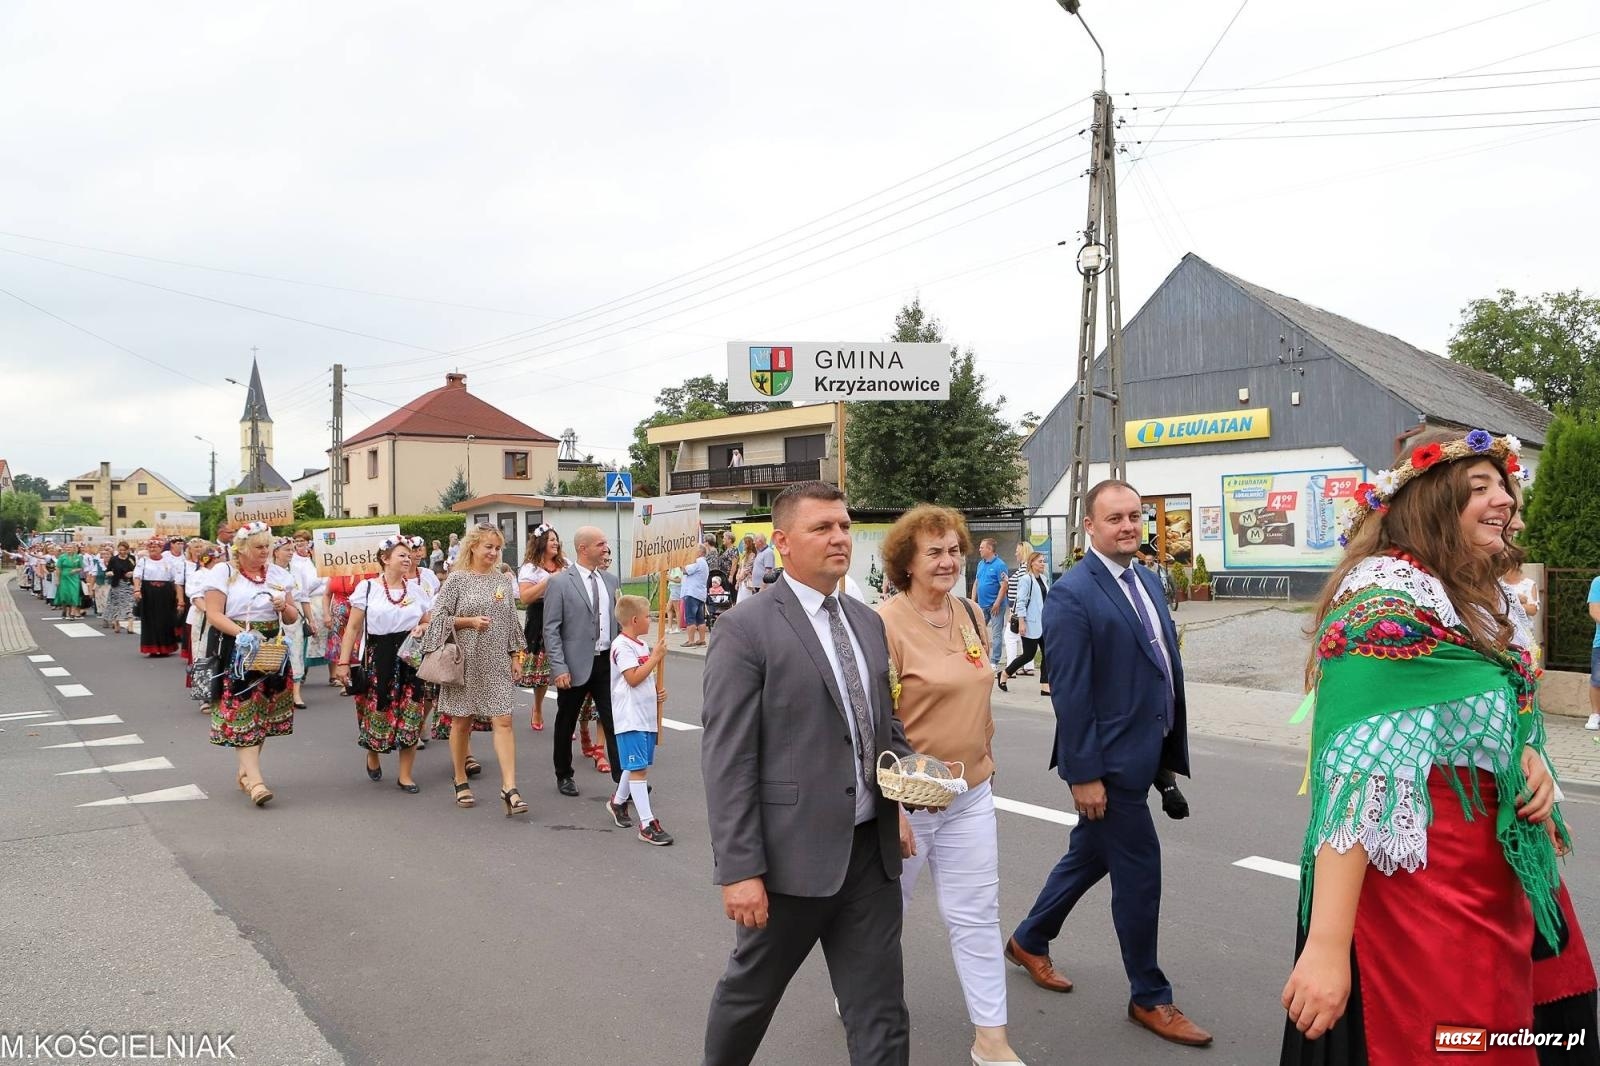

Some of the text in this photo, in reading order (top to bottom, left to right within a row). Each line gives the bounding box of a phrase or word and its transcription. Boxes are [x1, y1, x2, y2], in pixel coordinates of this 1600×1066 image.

[815, 350, 904, 369] GMINA
[814, 375, 940, 395] Krzyżanowice
[1168, 416, 1253, 438] LEWIATAN
[234, 509, 287, 521] Chałupki
[635, 532, 696, 559] Bieńkowice
[323, 549, 379, 567] Bolesła
